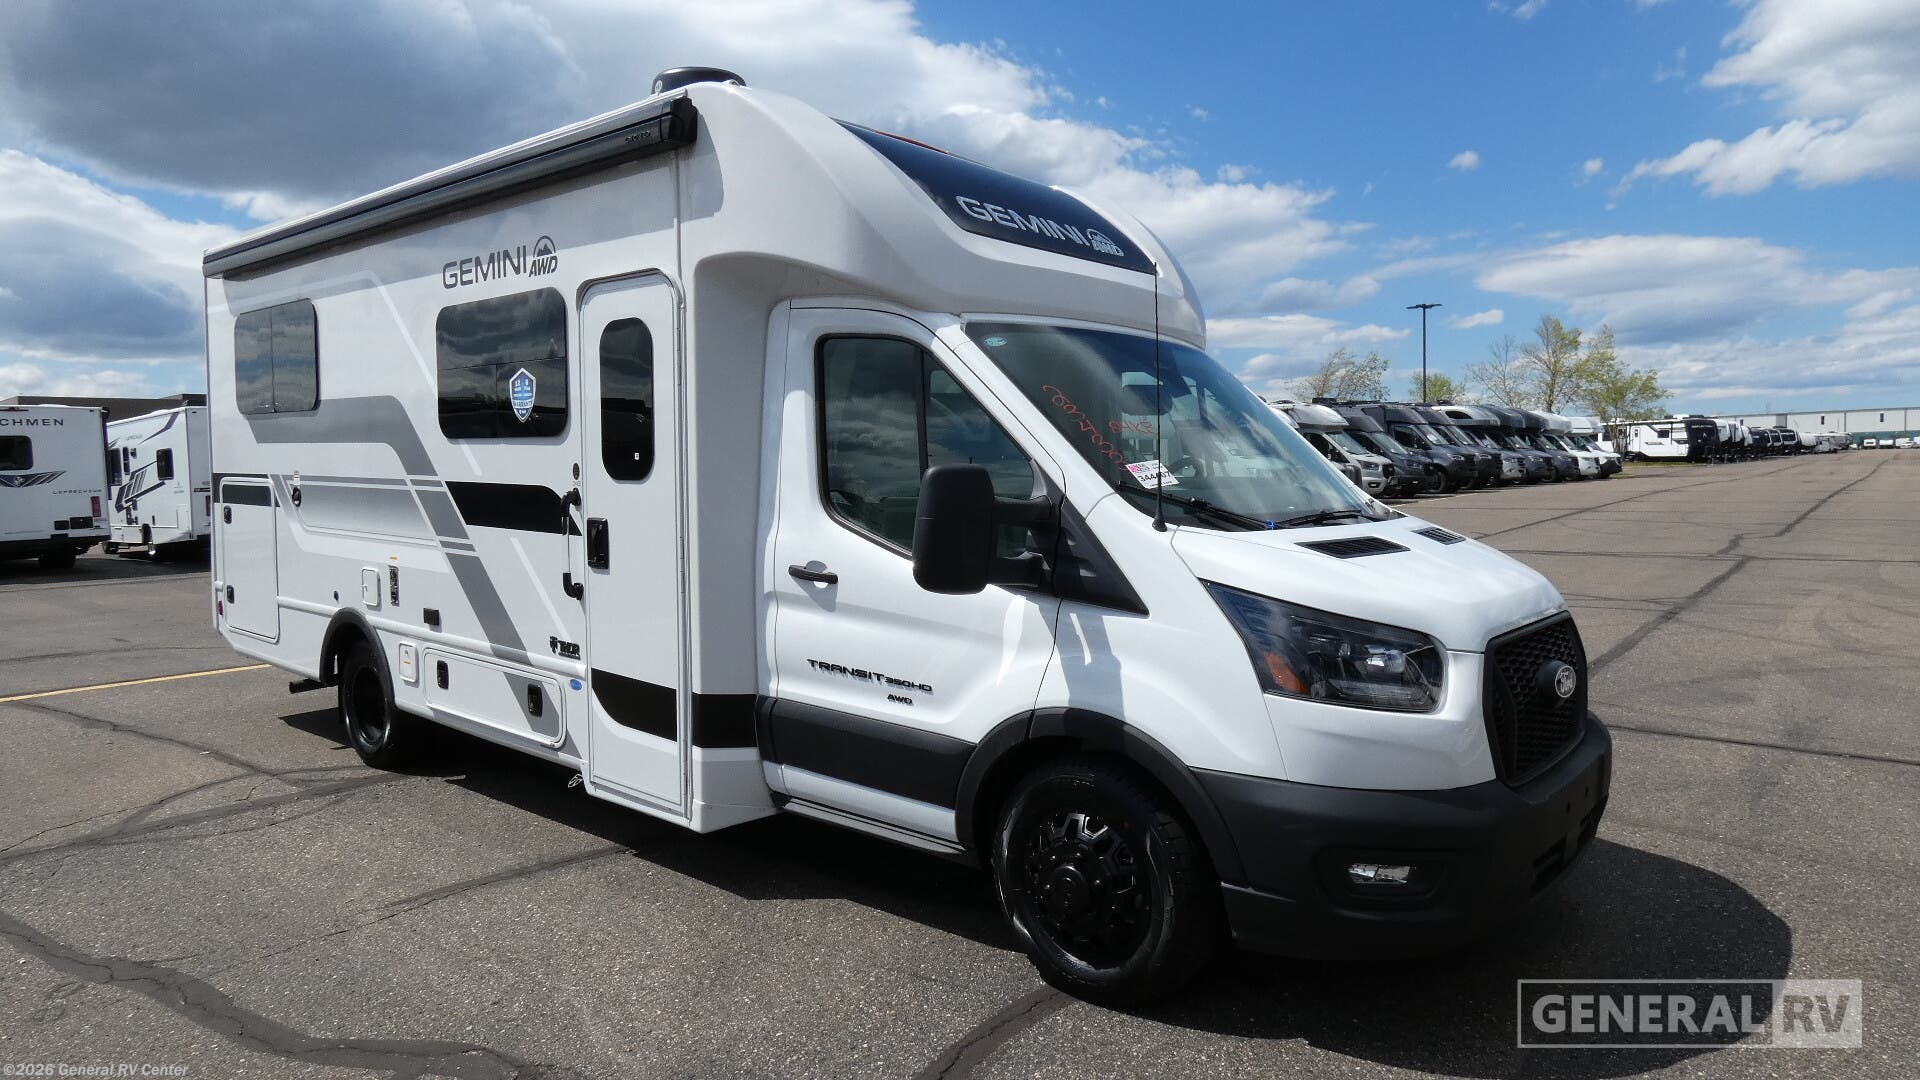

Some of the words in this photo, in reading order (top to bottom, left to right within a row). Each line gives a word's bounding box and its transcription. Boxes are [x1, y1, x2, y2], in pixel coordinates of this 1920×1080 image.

[955, 195, 1090, 246] GEMINI
[442, 245, 527, 289] GEMINI
[528, 255, 558, 278] AWD
[807, 658, 884, 682] TRANSIT
[887, 694, 913, 705] AWD
